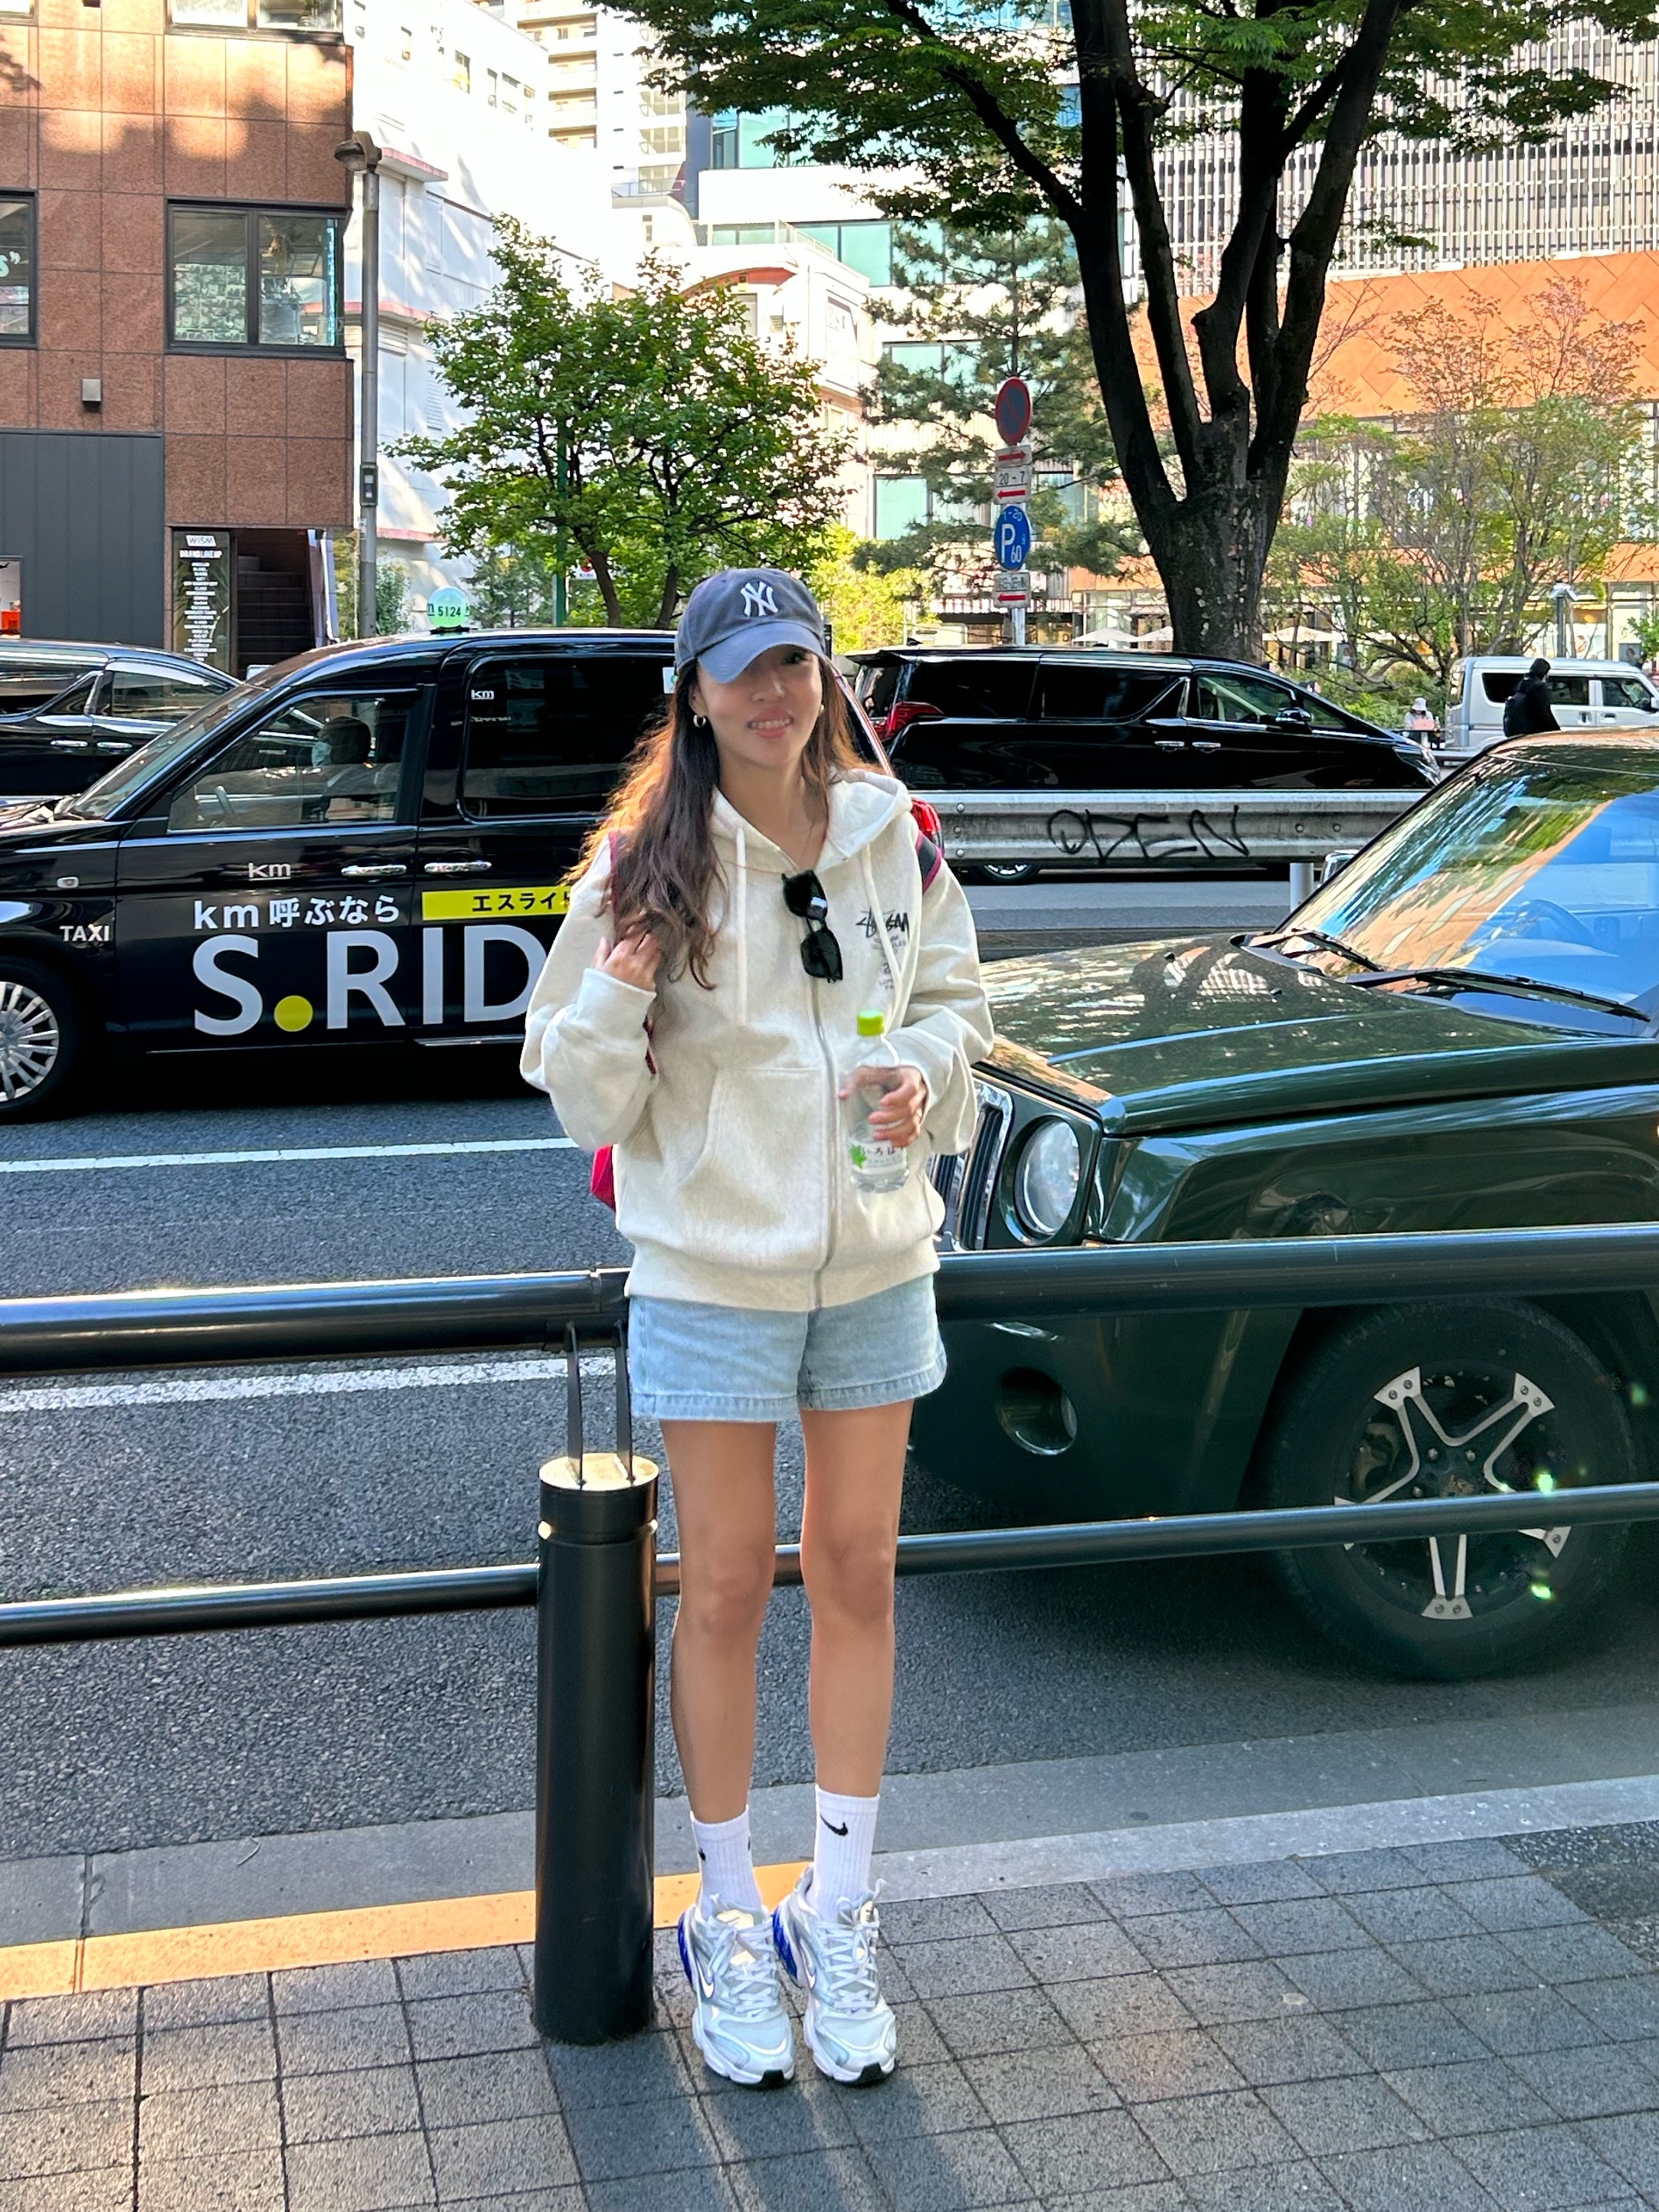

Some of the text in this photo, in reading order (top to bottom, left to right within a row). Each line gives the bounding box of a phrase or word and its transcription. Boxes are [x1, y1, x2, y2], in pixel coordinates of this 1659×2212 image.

[1010, 545, 1022, 563] 60
[741, 581, 778, 617] NY
[438, 605, 461, 617] 5124
[471, 689, 494, 700] km
[248, 862, 291, 881] km
[59, 924, 110, 942] TAXI
